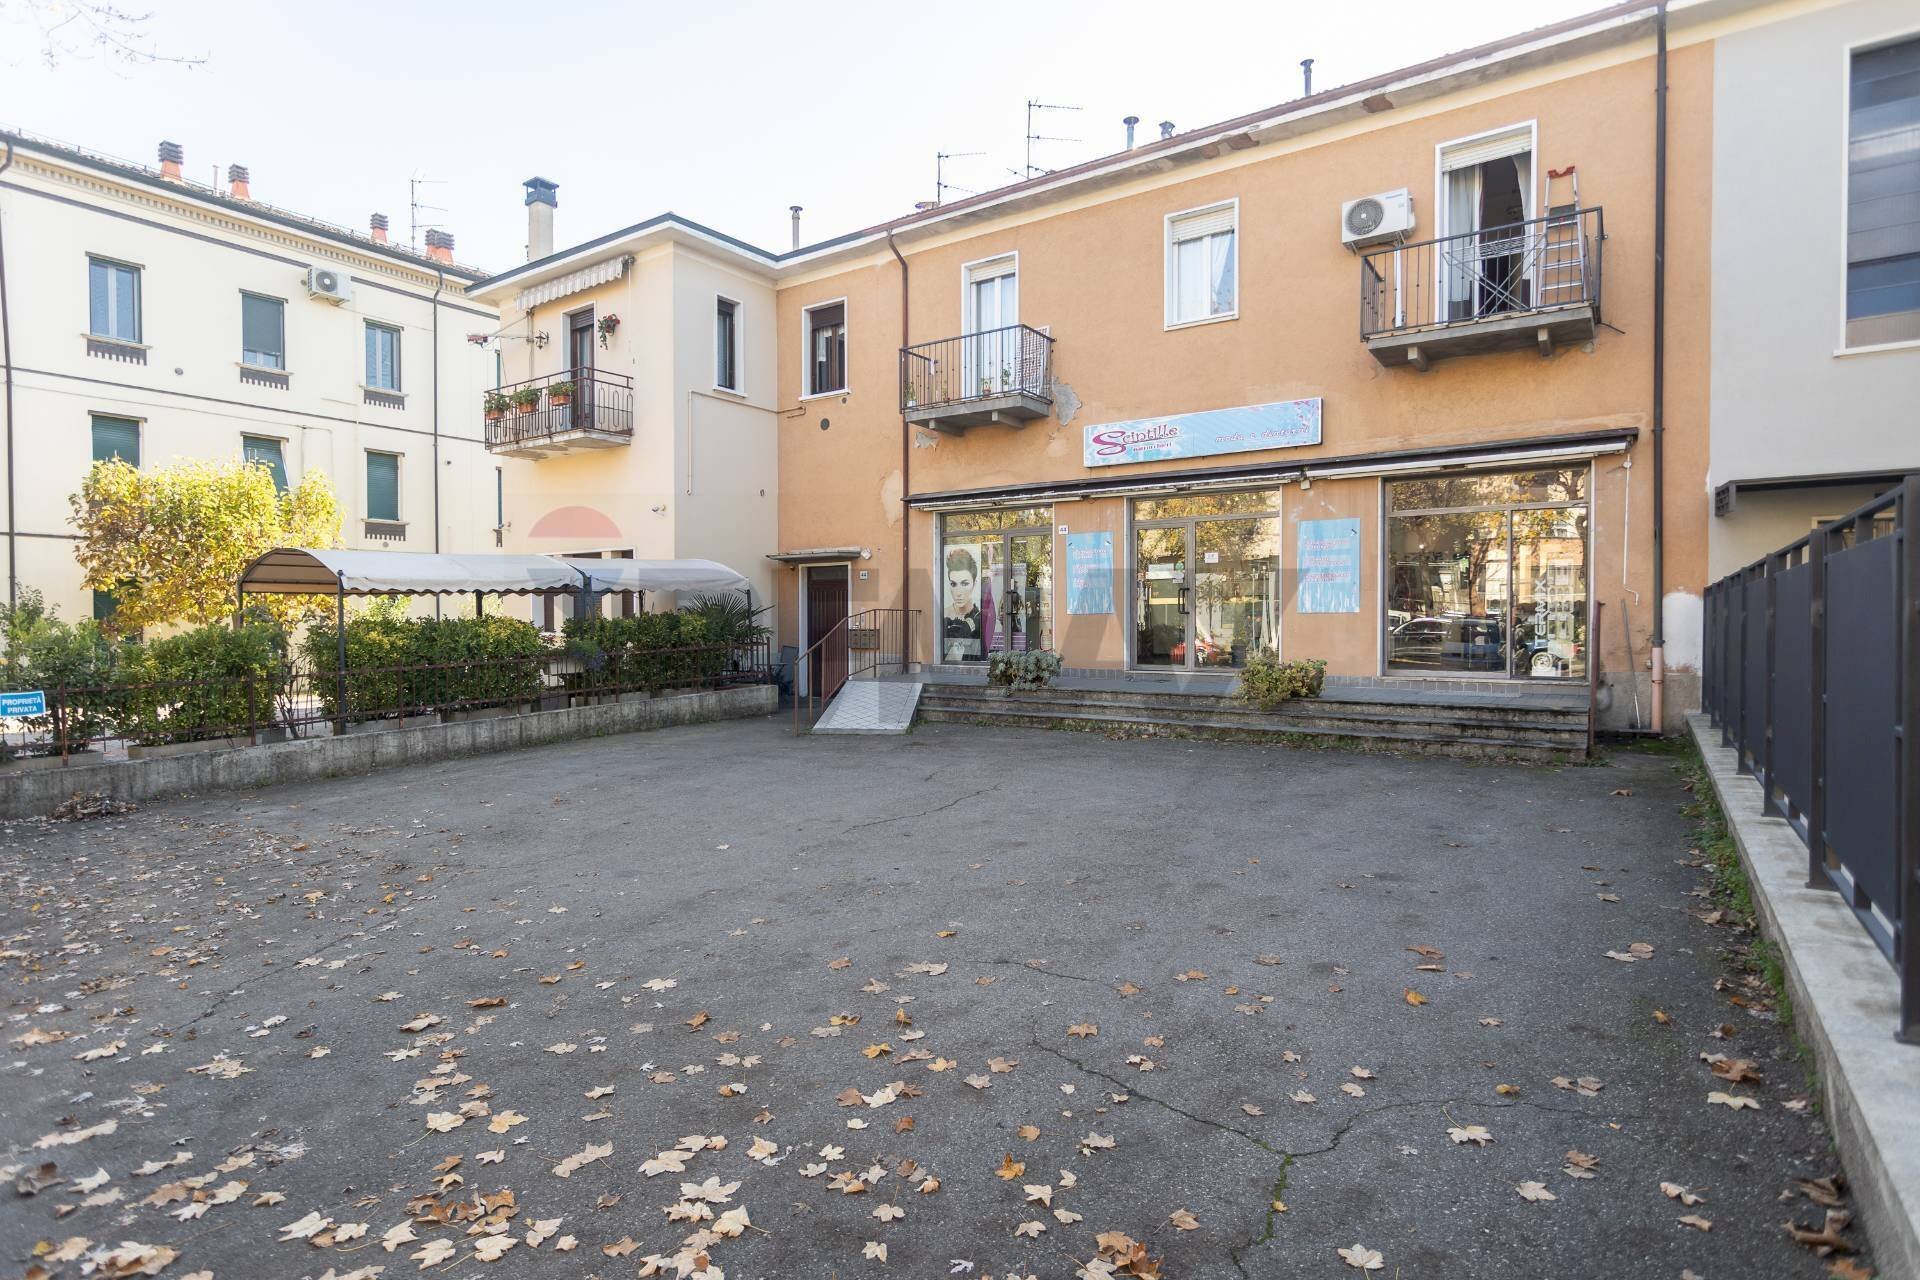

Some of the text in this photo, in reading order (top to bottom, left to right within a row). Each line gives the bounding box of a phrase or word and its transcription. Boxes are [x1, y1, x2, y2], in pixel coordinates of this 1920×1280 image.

[1534, 580, 1549, 649] TERMIX
[2, 696, 42, 706] PROPRIETÀ
[7, 705, 37, 714] PRIVATA
